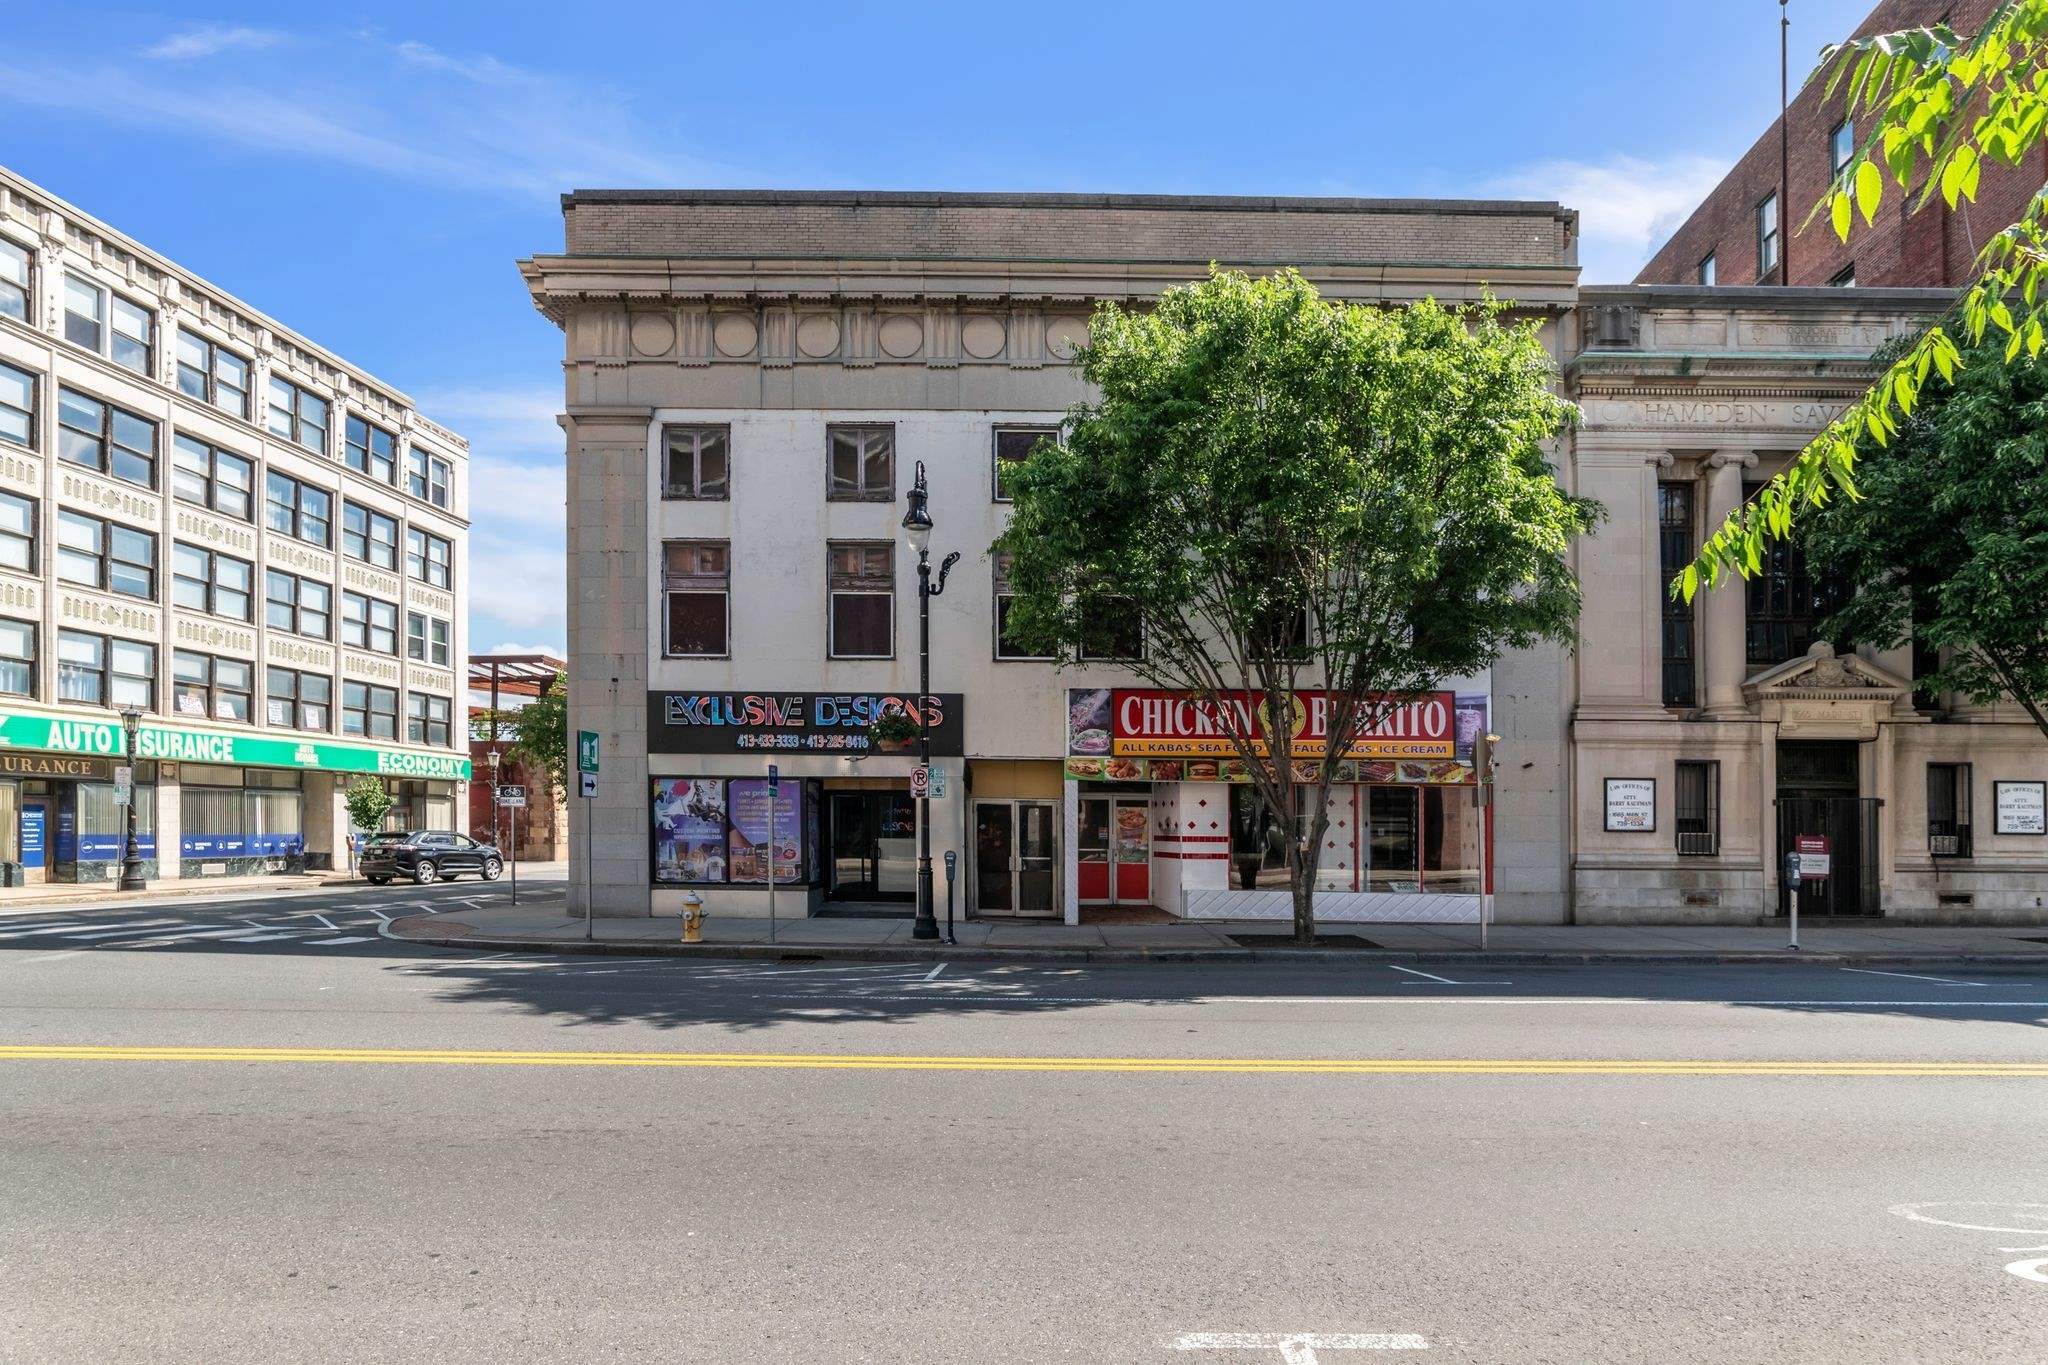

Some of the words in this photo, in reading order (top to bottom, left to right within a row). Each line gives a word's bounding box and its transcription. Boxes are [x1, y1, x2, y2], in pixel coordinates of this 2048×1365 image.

[1775, 326, 1850, 335] INCORPORATED
[1645, 403, 1768, 423] HAMPDEN
[664, 695, 805, 727] EXCLUSIVE
[1120, 695, 1253, 736] CHICKEN
[1310, 696, 1447, 738] BRRITO
[47, 720, 113, 752] AUTO
[1121, 743, 1145, 752] ALL
[1148, 743, 1192, 752] KABAS
[1198, 744, 1221, 752] SEA
[1380, 745, 1400, 753] ICE
[1402, 745, 1447, 753] CREAM
[0, 756, 92, 775] URANCE
[378, 752, 464, 774] ECONOMY
[752, 788, 769, 798] prin
